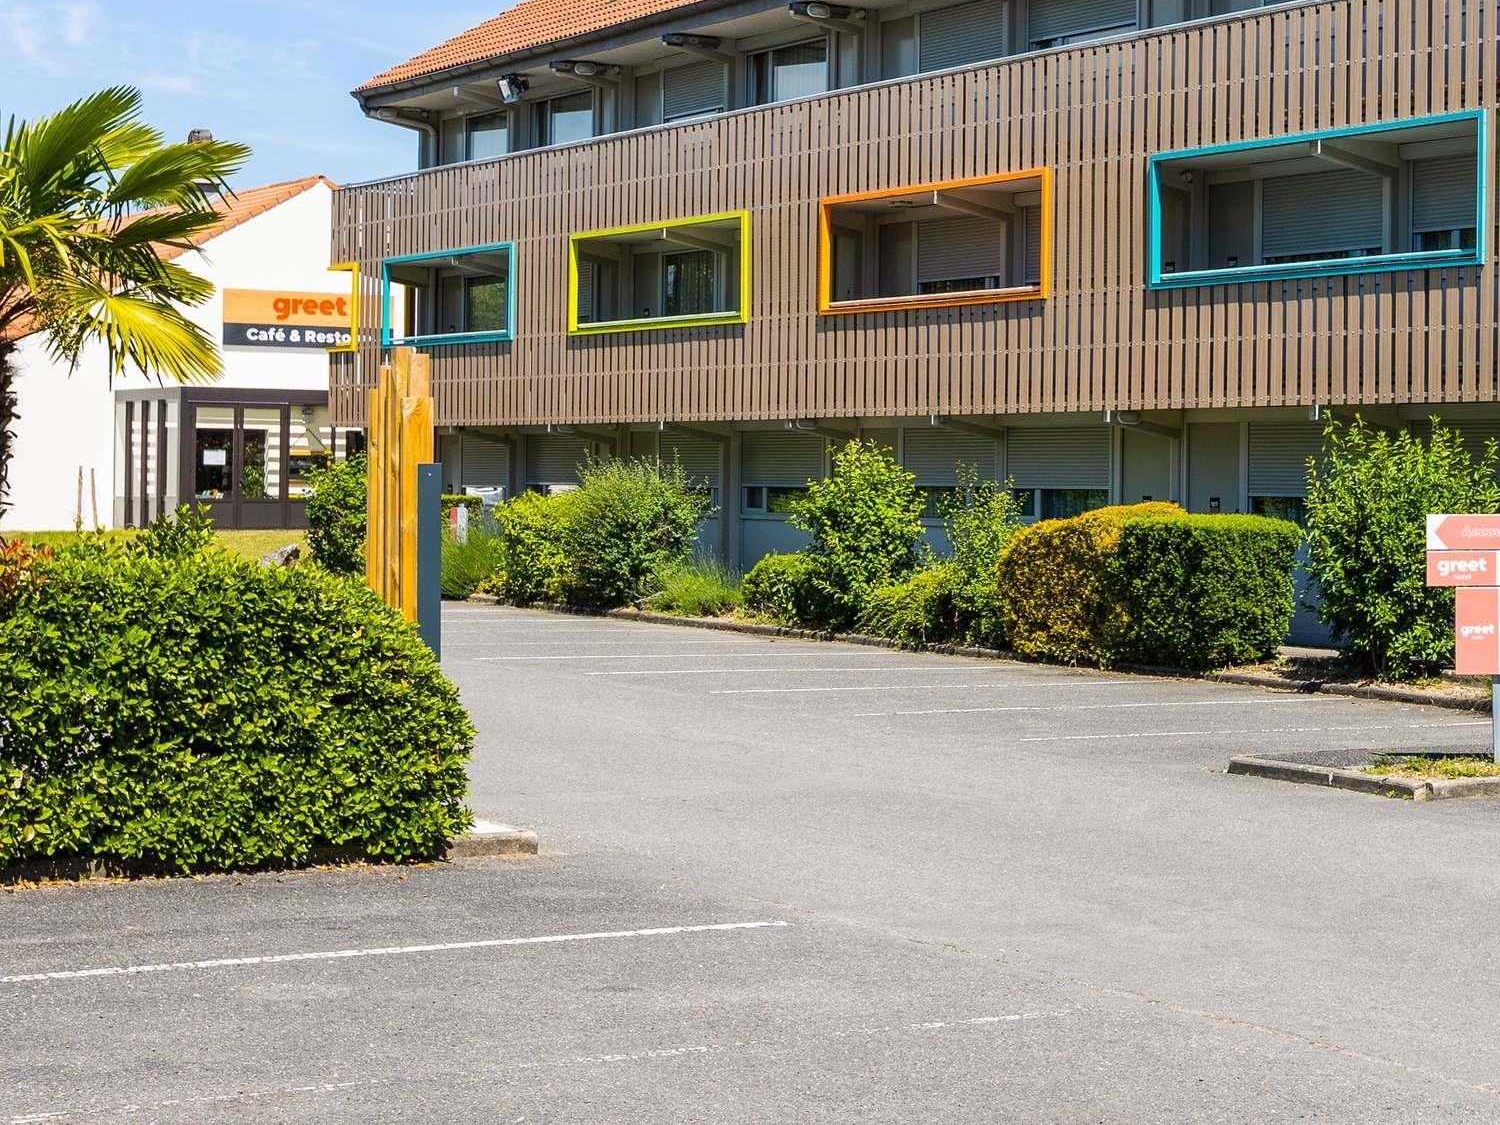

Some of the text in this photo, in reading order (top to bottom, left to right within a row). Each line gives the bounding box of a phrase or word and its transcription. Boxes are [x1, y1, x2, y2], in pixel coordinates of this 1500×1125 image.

[273, 296, 348, 320] greet
[246, 327, 374, 344] Café & Resto
[1437, 557, 1488, 576] greet
[1460, 623, 1495, 638] greet
